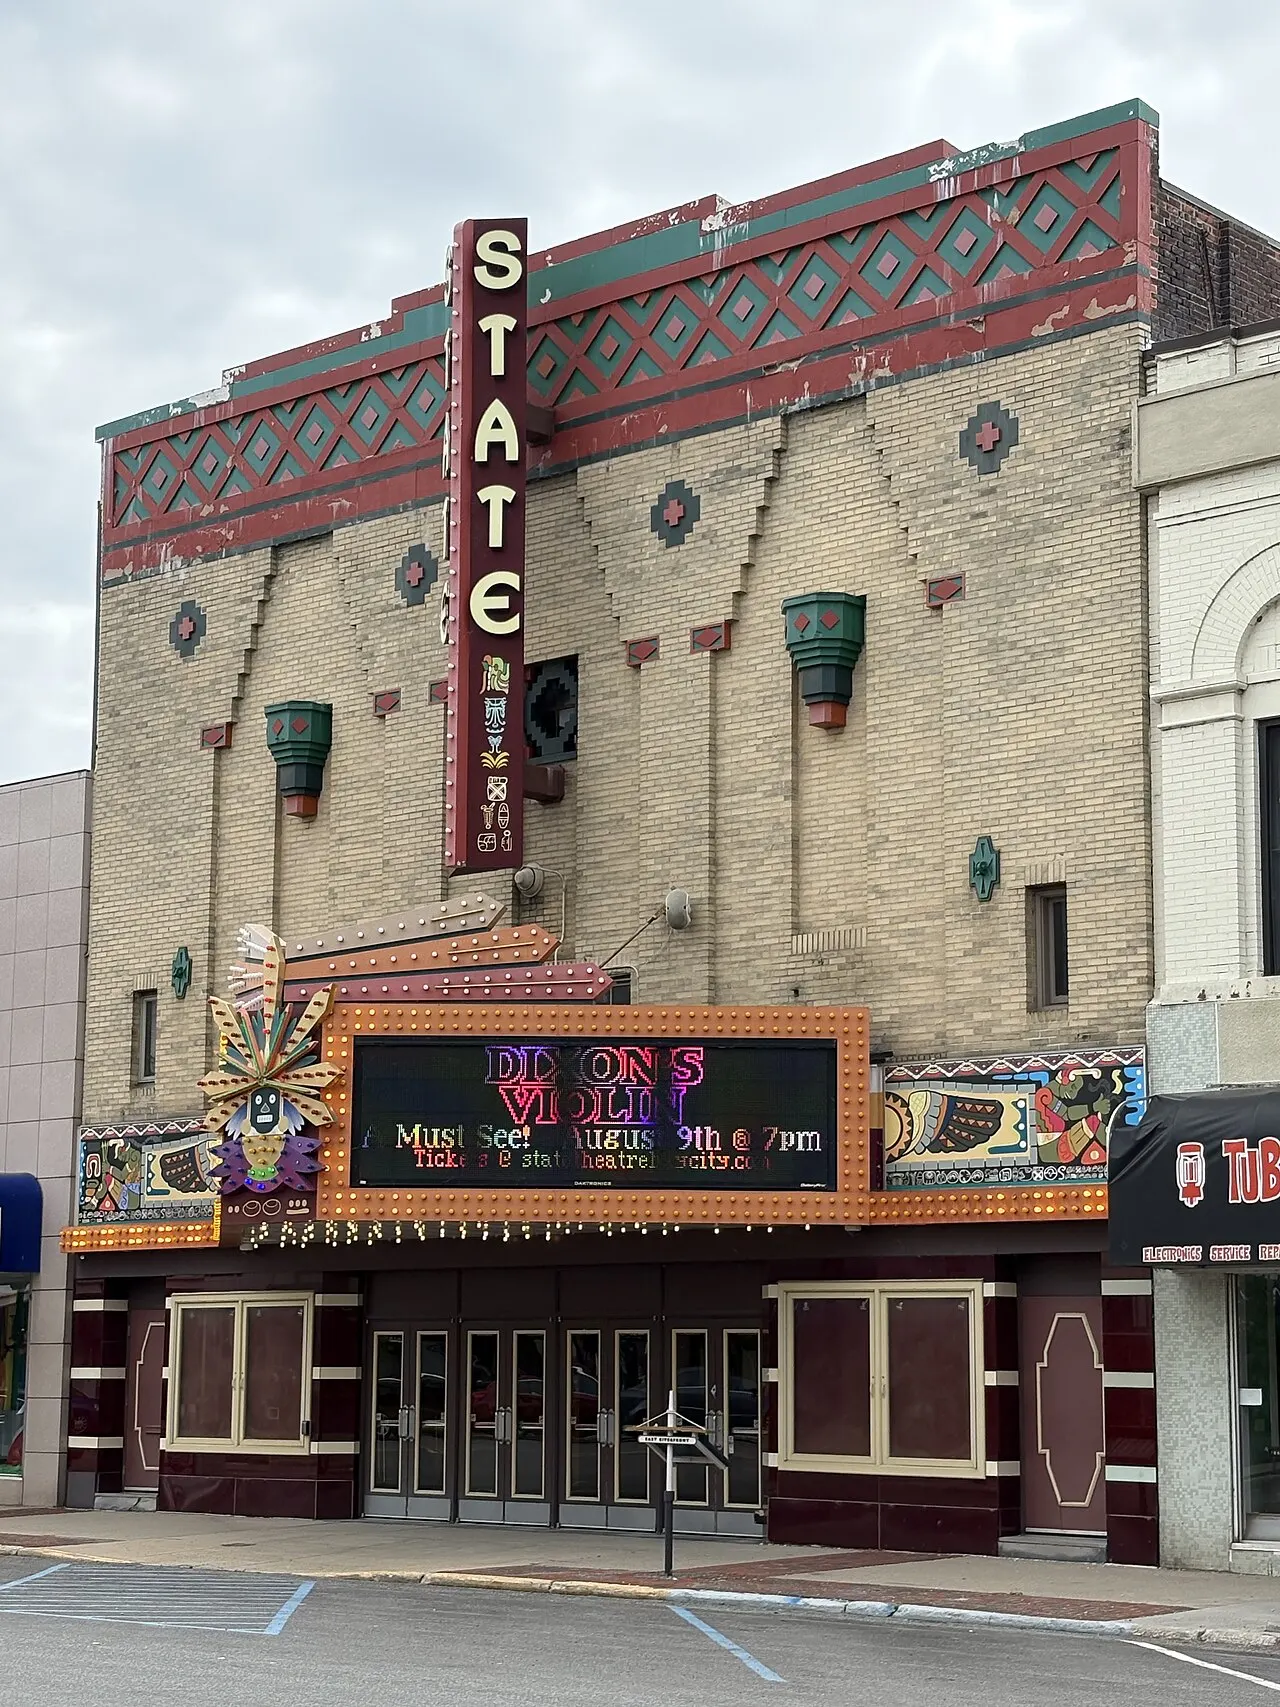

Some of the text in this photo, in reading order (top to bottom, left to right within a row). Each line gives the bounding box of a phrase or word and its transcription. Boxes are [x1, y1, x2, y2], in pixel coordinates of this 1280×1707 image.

[470, 229, 524, 636] STATE
[485, 1046, 704, 1085] DIXONS
[396, 1123, 465, 1149] Must
[477, 1124, 531, 1149] See!
[570, 1124, 658, 1150] Augus
[677, 1125, 722, 1151] 9th
[732, 1128, 750, 1151] @
[763, 1126, 823, 1152] 7pm
[413, 1149, 489, 1168] Tickes
[1209, 1244, 1251, 1261] SERVICE
[1258, 1243, 1280, 1260] REP
